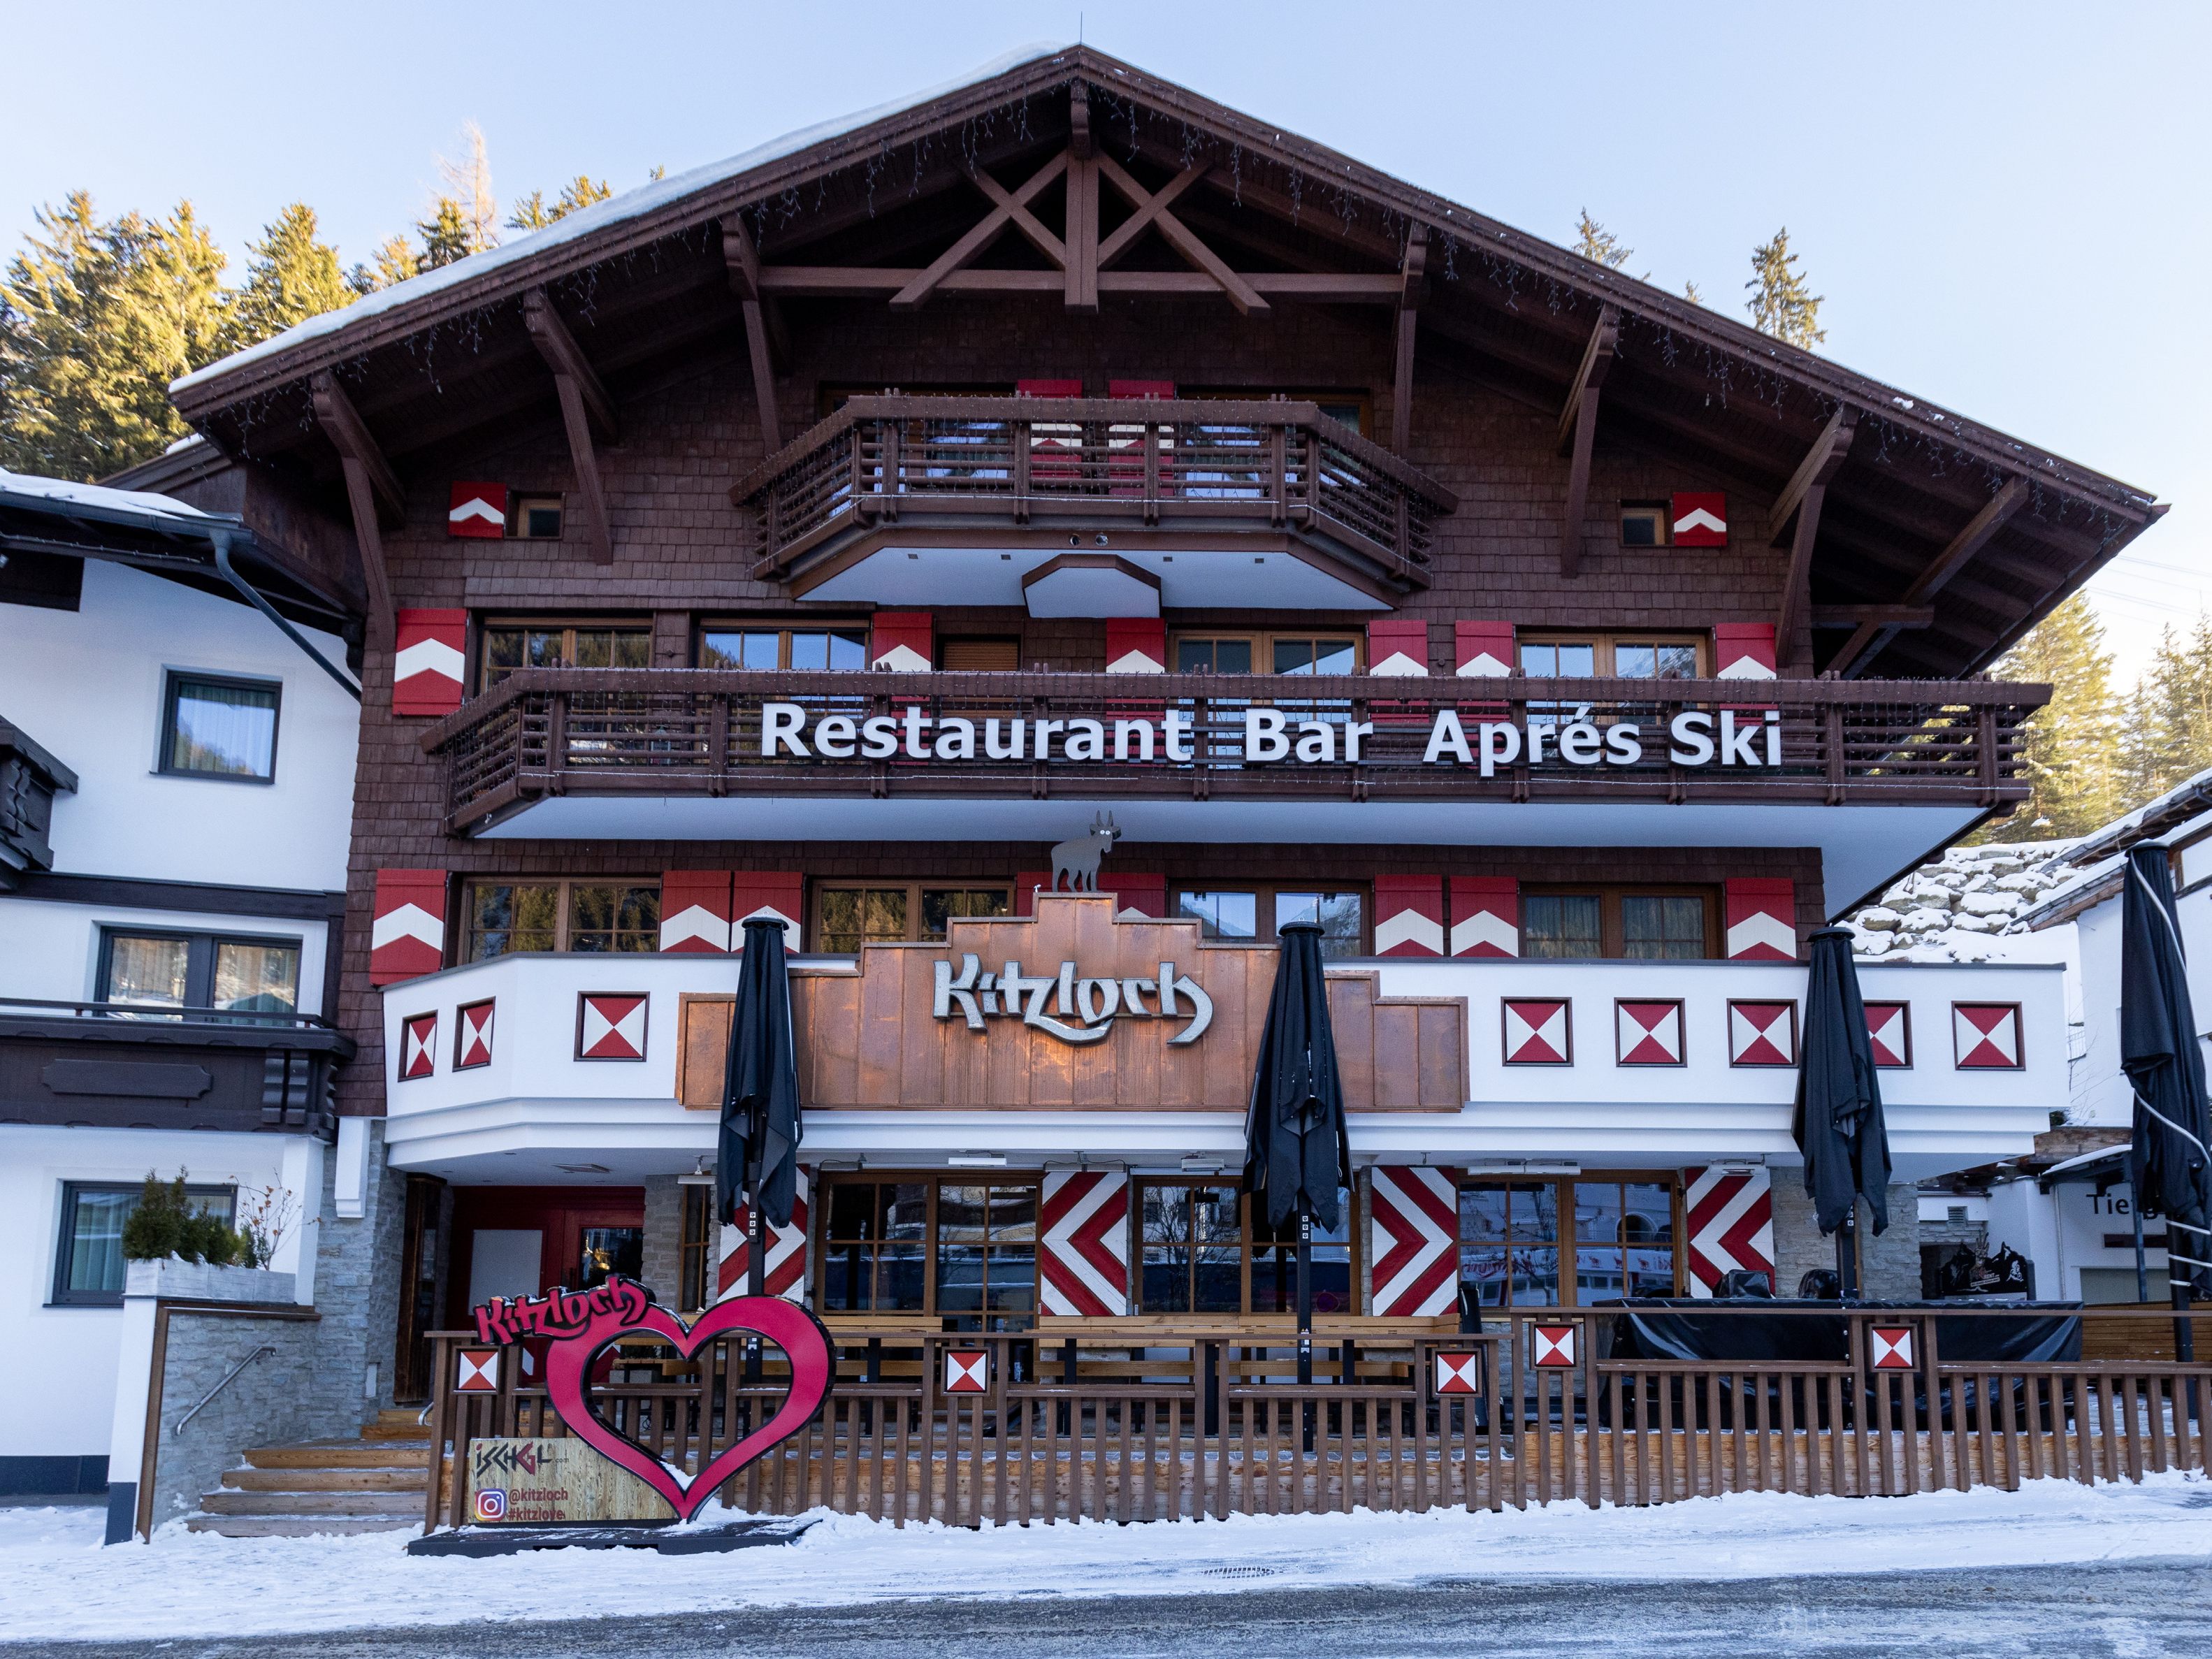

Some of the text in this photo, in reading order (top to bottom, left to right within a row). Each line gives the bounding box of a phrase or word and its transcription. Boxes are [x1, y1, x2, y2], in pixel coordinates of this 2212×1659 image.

[760, 702, 1781, 778] Restaurant Bar Aprés Ski
[933, 953, 1214, 1045] Kitzloch
[475, 1275, 650, 1345] Kitzloch
[508, 1507, 565, 1521] #kitzlove
[509, 1487, 568, 1505] @kitzloch
